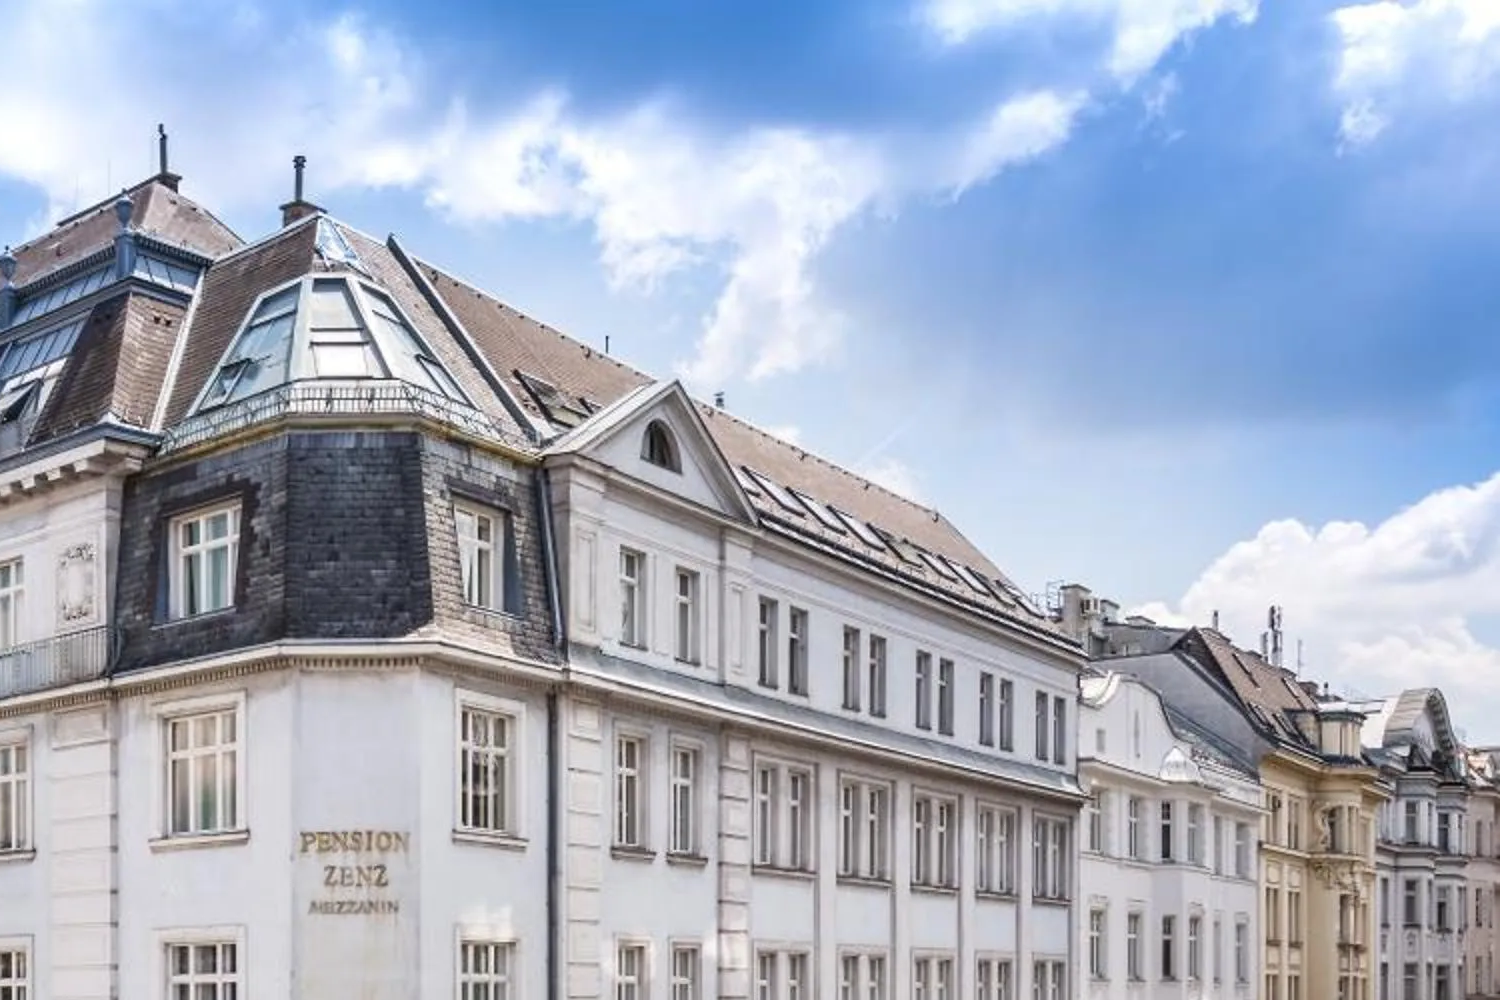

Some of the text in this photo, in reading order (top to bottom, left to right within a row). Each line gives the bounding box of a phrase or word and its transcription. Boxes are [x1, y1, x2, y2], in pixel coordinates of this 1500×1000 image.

[301, 831, 411, 854] PENSION
[323, 865, 390, 888] ZENZ
[308, 899, 400, 916] MEZZANIN
